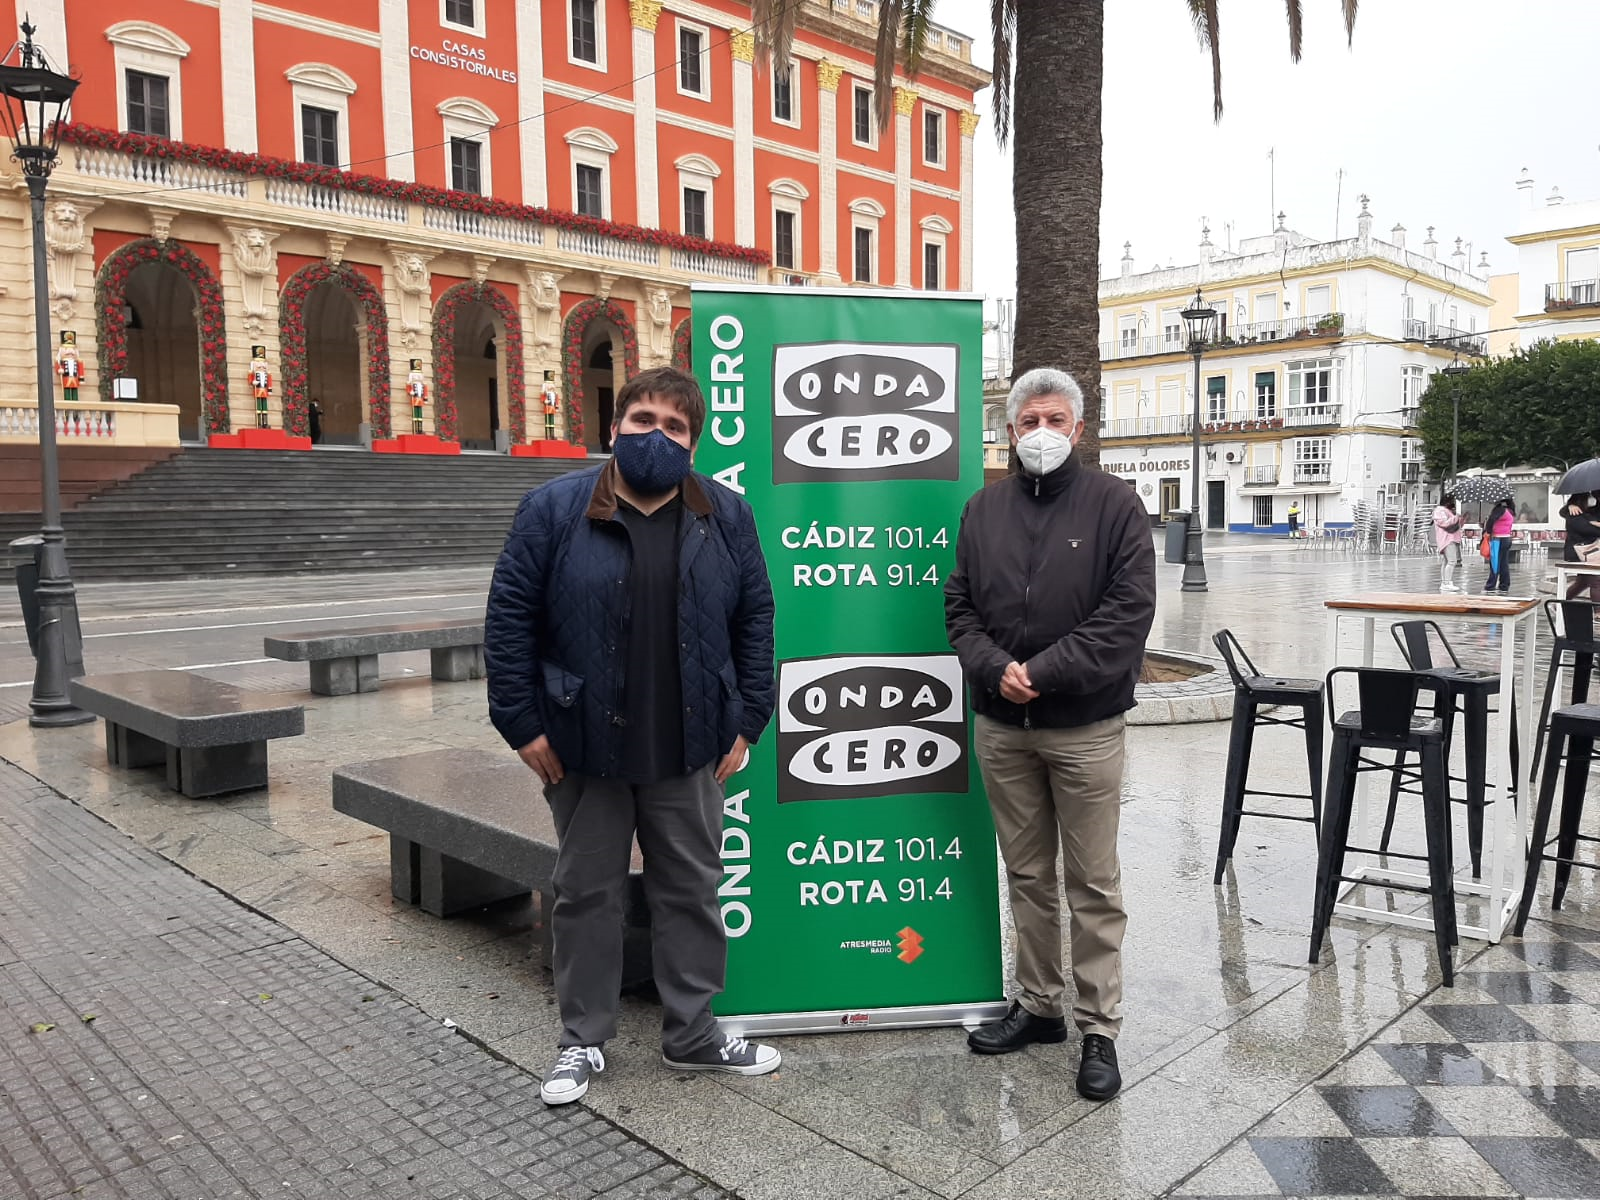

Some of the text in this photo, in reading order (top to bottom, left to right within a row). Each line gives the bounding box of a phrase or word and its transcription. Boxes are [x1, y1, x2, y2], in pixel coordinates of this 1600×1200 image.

[410, 46, 517, 84] CONSISTORIALES
[442, 39, 486, 61] CASAS
[709, 315, 745, 446] CERO
[799, 372, 930, 400] ONDA
[807, 425, 931, 457] CERO
[1139, 459, 1190, 473] DOLORES
[781, 521, 949, 550] CÁDIZ 101.4
[793, 564, 939, 587] ROTA 91.4
[804, 684, 937, 715] ONDA
[812, 738, 940, 774] CERO
[718, 788, 752, 938] ONDA
[786, 835, 963, 866] CÁDIZ 101.4
[799, 877, 953, 907] ROTA 91.4
[840, 939, 892, 949] ATRESMEDIA
